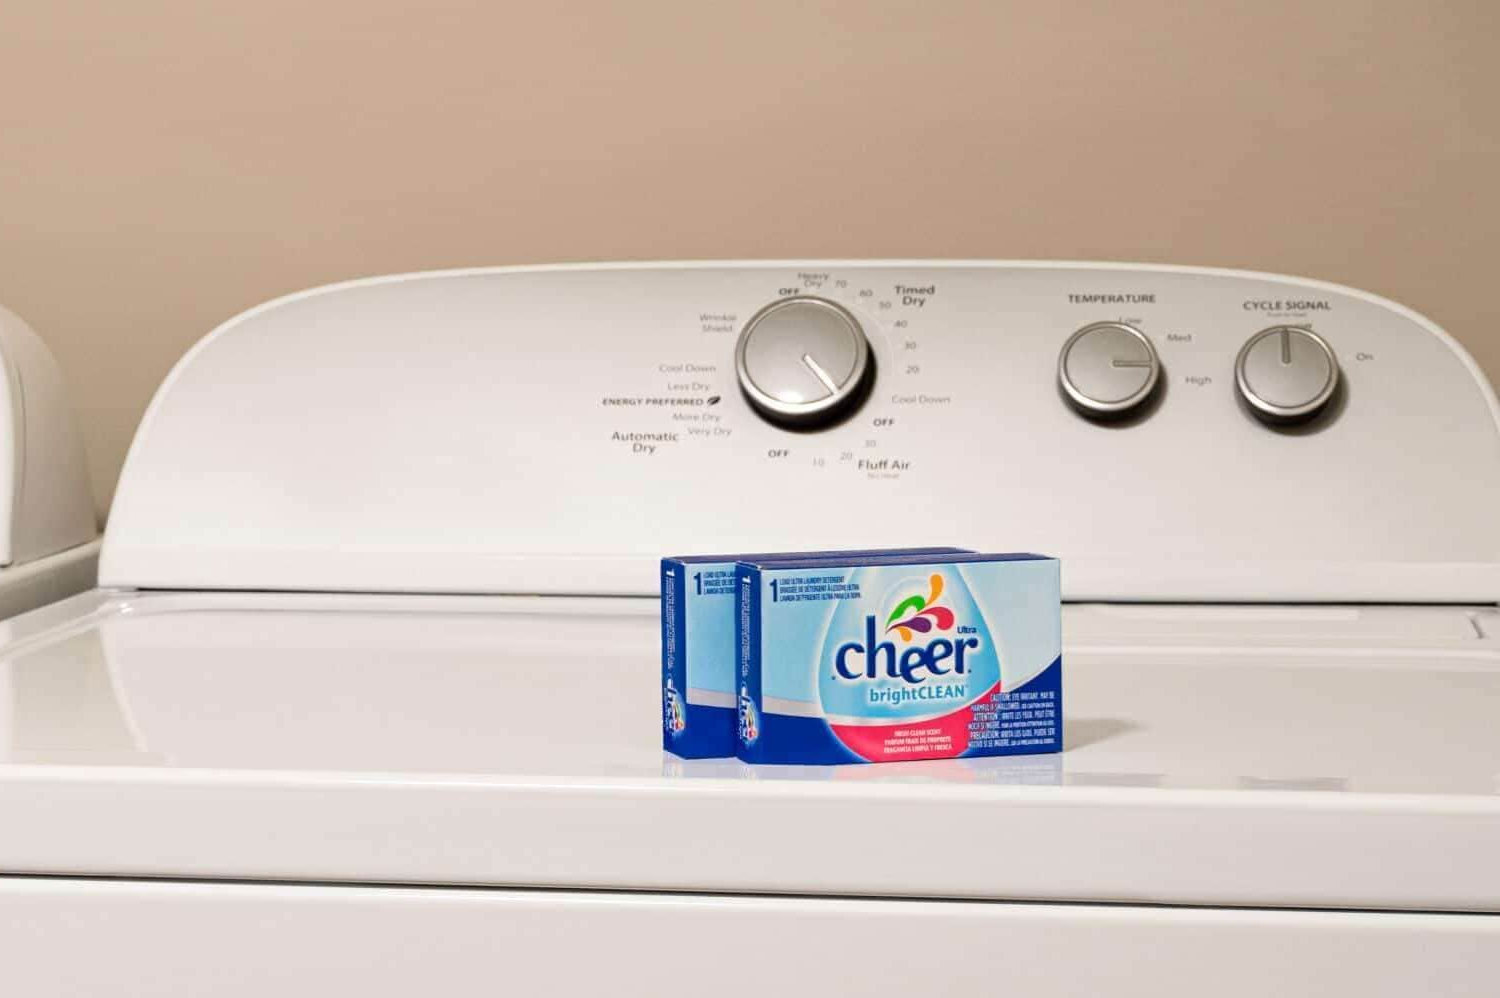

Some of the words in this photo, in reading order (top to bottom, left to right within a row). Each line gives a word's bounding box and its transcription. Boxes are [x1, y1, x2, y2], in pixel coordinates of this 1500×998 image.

[778, 287, 800, 296] OFF
[894, 284, 935, 296] Timed
[902, 296, 926, 308] Dry
[1068, 293, 1157, 304] TEMPERATURE
[1242, 300, 1283, 311] CYCLE
[1284, 300, 1332, 311] SIGNAL
[1355, 351, 1375, 361] On
[659, 363, 683, 373] Cool
[685, 363, 717, 373] Down
[1185, 375, 1213, 387] High
[691, 381, 711, 393] Dry
[602, 397, 643, 406] ENERGY
[645, 397, 704, 406] PREFERRED
[891, 395, 917, 404] Cool
[919, 395, 951, 404] Down
[872, 417, 895, 427] OFF
[611, 431, 679, 441] Automatic
[632, 442, 656, 455] Dry
[767, 449, 790, 458] OFF
[857, 459, 888, 471] Fluff
[891, 459, 911, 471] Air
[693, 571, 702, 595] 1
[769, 578, 778, 602] 1
[957, 625, 977, 634] Ultra
[835, 615, 979, 684] cheer
[870, 685, 965, 705] brightCLEAN
